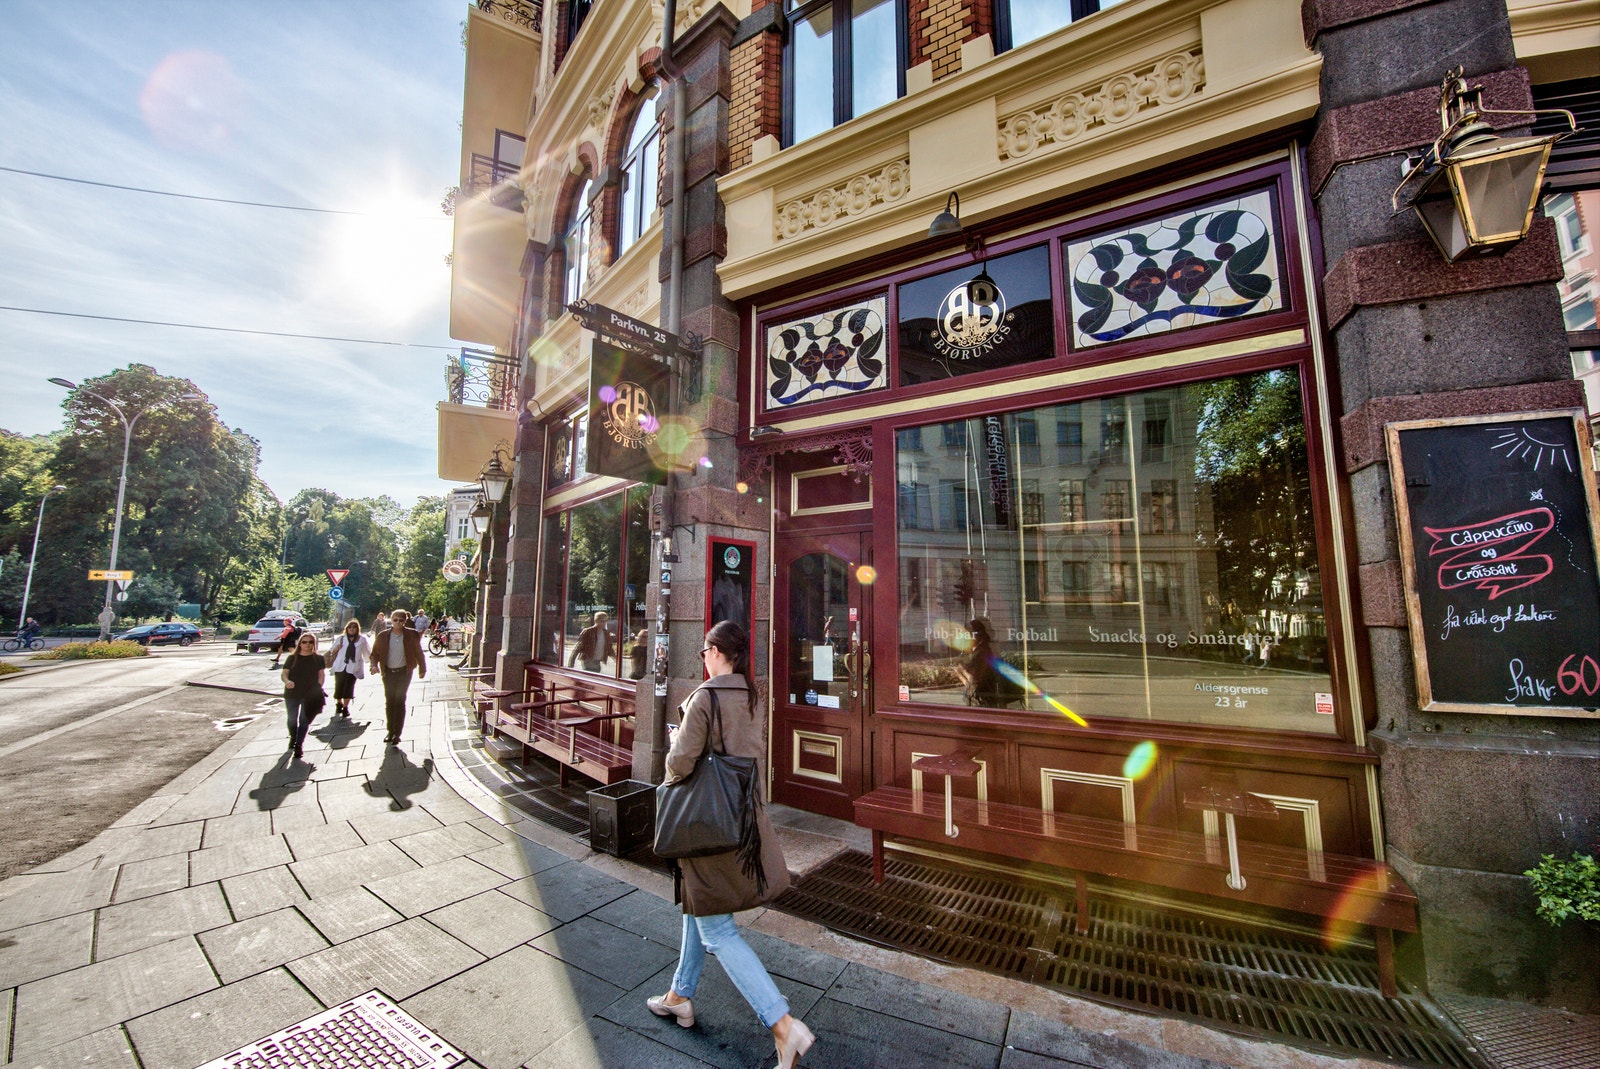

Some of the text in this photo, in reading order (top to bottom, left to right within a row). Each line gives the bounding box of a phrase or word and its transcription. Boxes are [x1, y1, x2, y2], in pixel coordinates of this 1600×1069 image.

[610, 313, 667, 344] Parkvn. 25
[933, 325, 1011, 361] BJØRUNGS
[603, 420, 658, 450] BJØRUNGS
[1450, 520, 1534, 546] Cappuccino
[1481, 548, 1497, 558] og
[1456, 562, 1518, 581] Croissant
[924, 627, 1282, 648] Pub-Bar Fotball Snacks og Småretter
[1557, 653, 1600, 697] 60
[1194, 683, 1269, 696] Aldersgrense
[1214, 696, 1248, 708] 23 år
